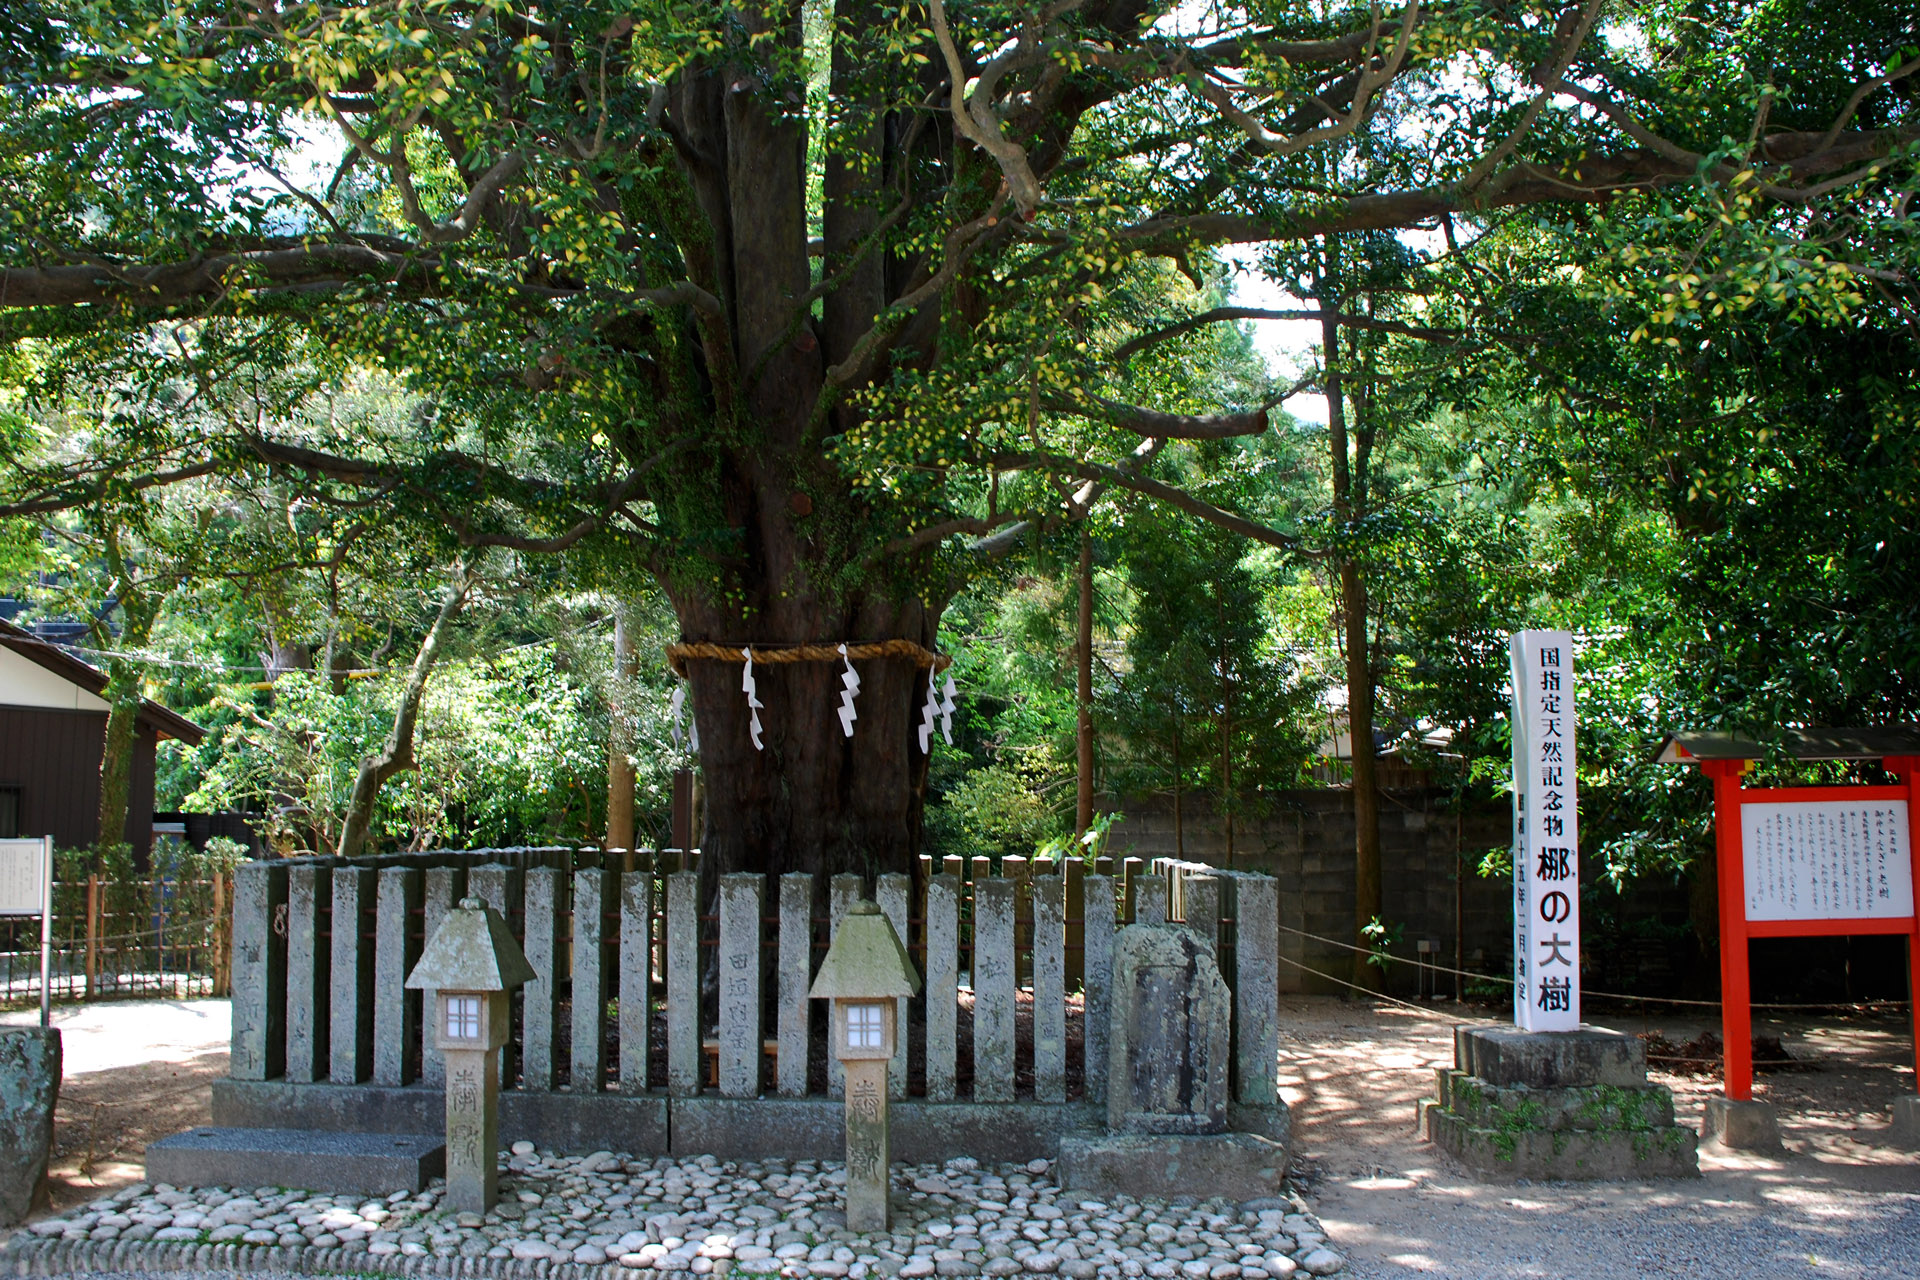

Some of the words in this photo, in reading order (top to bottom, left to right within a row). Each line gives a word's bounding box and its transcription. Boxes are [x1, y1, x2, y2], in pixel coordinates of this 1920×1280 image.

[1540, 647, 1563, 836] 国指定天然記念物
[1536, 846, 1571, 1012] 梛の大樹
